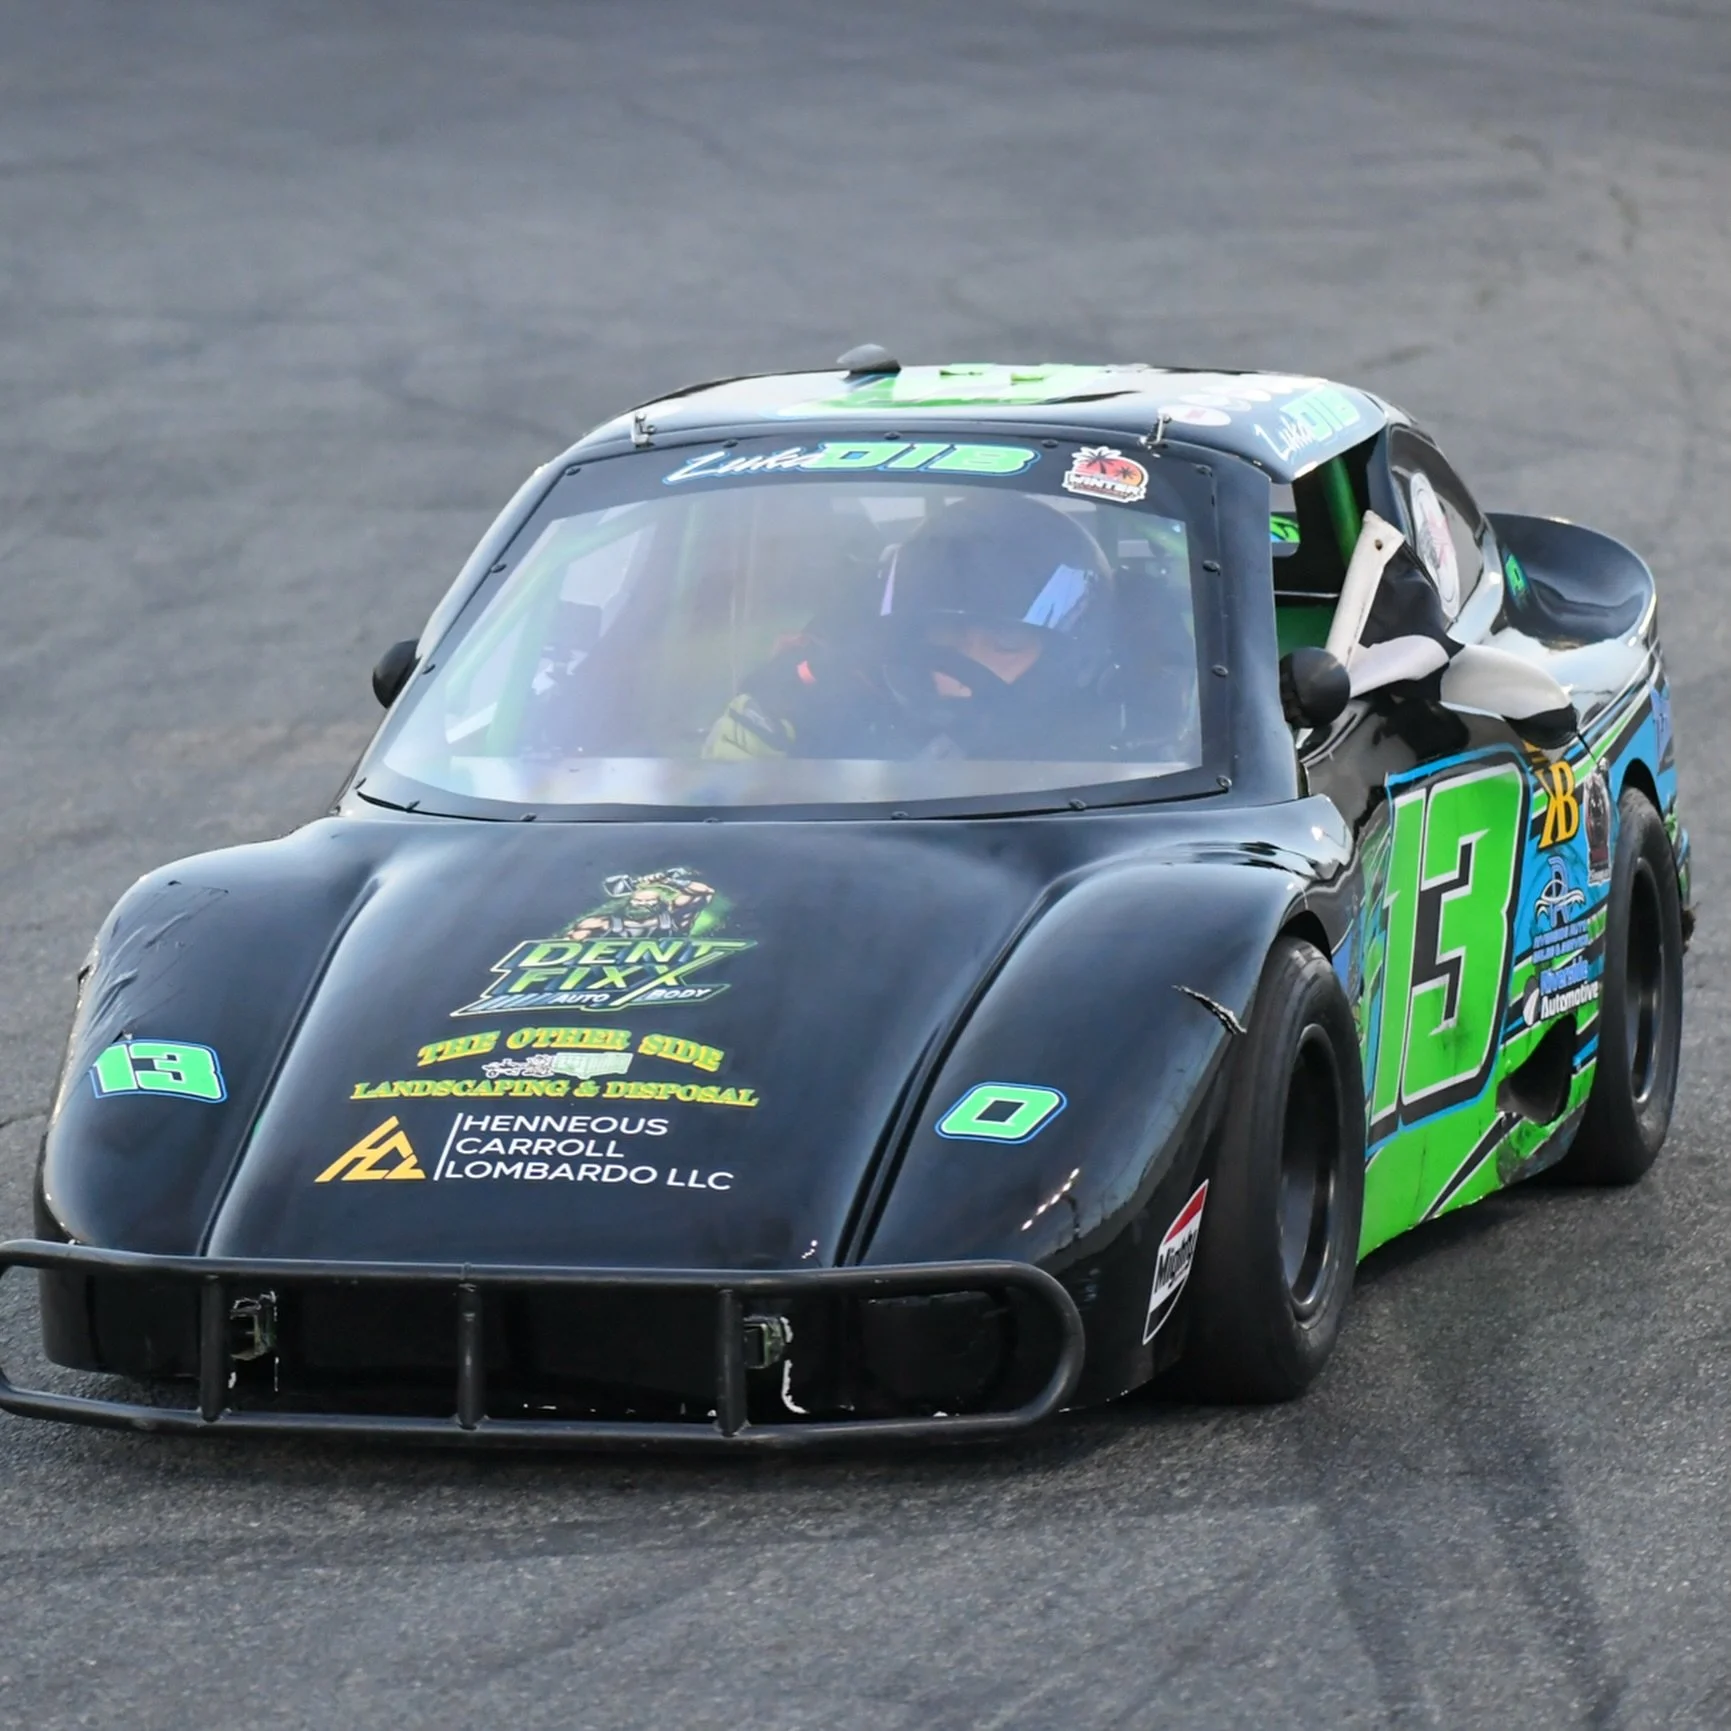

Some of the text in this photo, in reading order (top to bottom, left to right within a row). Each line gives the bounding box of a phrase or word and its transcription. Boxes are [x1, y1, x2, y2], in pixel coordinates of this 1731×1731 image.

[518, 940, 749, 967] DENT
[1370, 762, 1523, 1125] 13
[550, 988, 711, 1005] AUTO BODY
[1540, 981, 1599, 1020] Automotive
[416, 1027, 725, 1072] THE OTHER SIDE
[92, 1042, 222, 1100] 13
[350, 1079, 761, 1107] LANDSCAPING & DISPOSAL
[462, 1115, 670, 1136] HENNEOUS
[454, 1138, 625, 1158] CARROLL
[444, 1160, 735, 1190] LOMBARDO LLC
